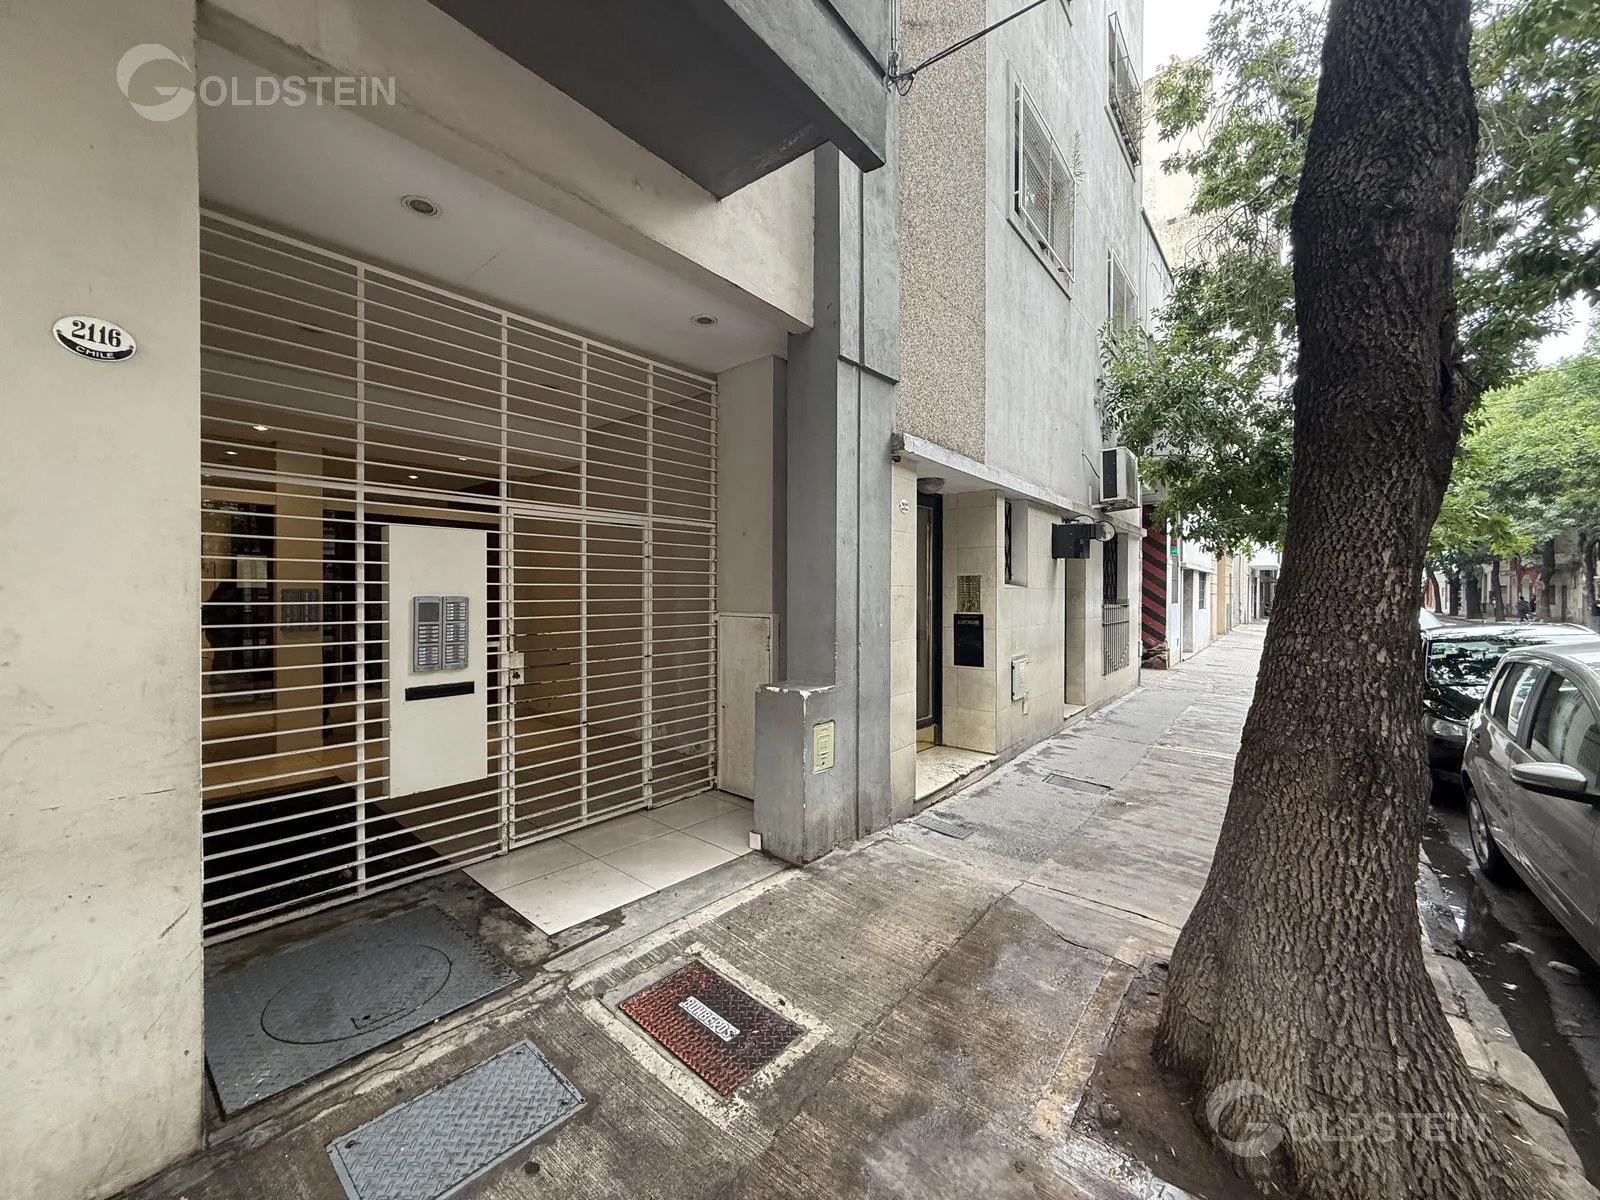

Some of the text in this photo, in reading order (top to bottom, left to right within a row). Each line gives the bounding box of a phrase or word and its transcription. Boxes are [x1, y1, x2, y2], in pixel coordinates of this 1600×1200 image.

[71, 319, 122, 348] 2116
[75, 345, 115, 360] CHILE
[681, 997, 738, 1040] BOMBEROS
